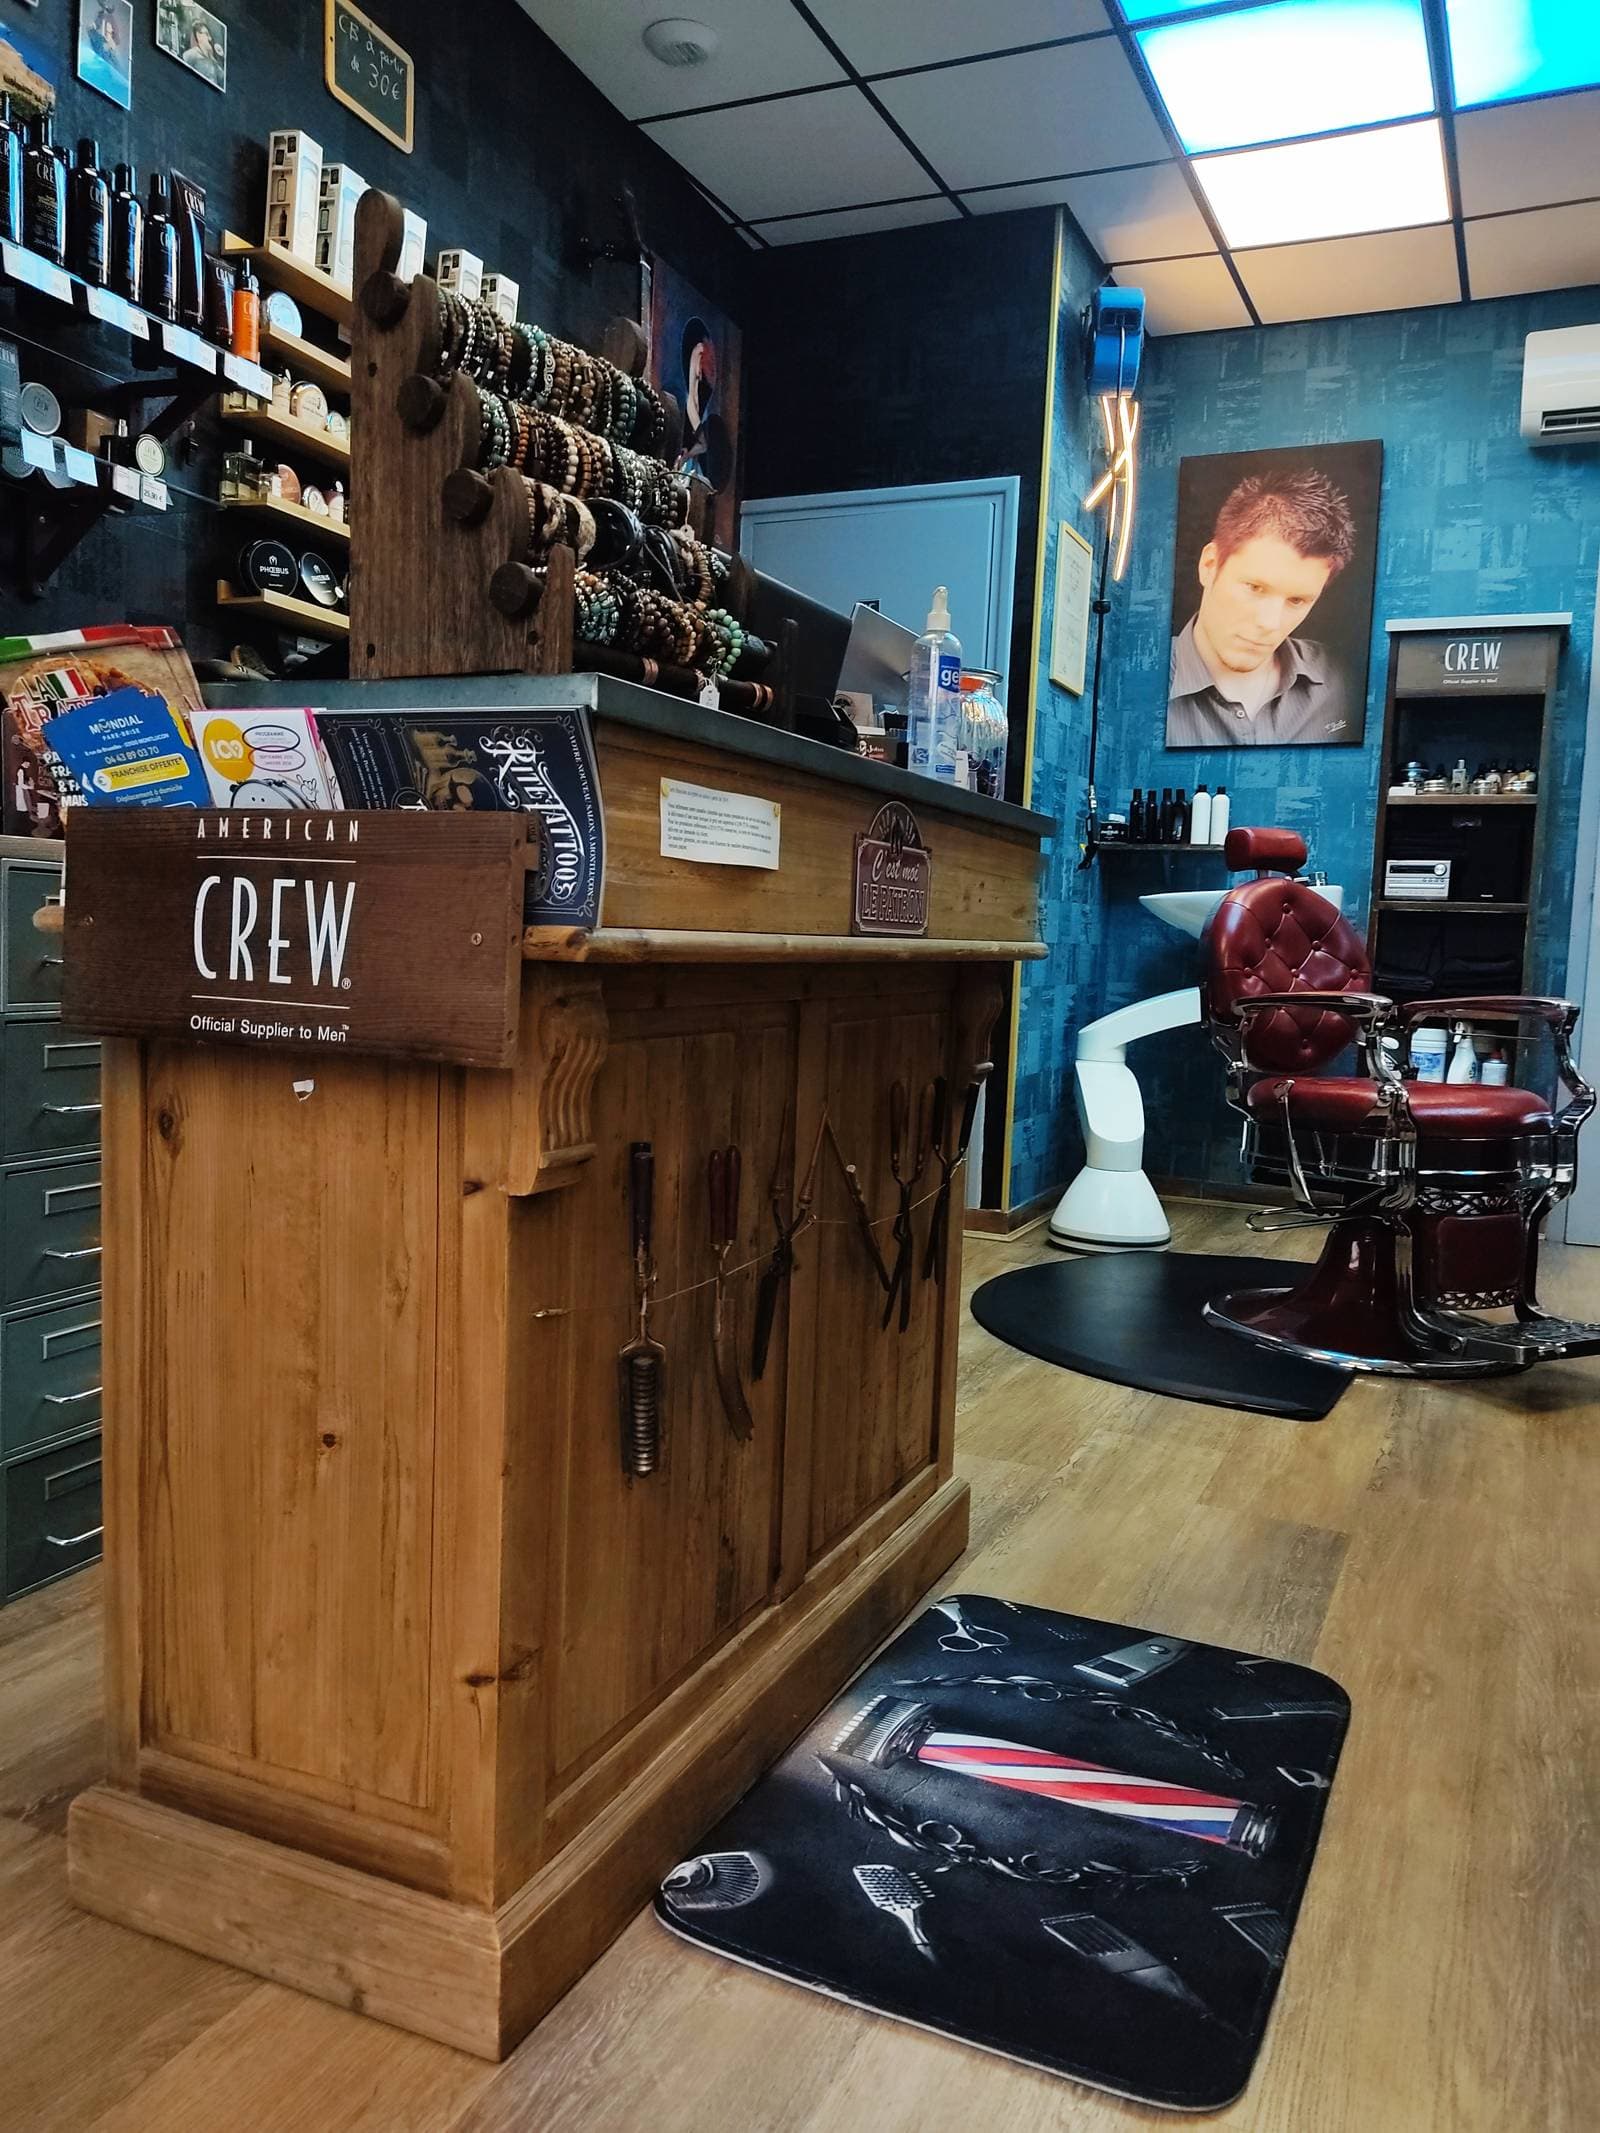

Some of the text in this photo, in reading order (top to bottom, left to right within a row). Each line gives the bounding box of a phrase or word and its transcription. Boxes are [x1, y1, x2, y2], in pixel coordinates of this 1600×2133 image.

[338, 14, 359, 41] CB
[350, 55, 360, 73] de
[42, 752, 62, 765] PA
[110, 763, 150, 780] FRANCHISE
[57, 780, 68, 793] &
[197, 816, 360, 842] AMERICAN
[862, 882, 925, 924] LE PATRON
[190, 1014, 236, 1033] Official
[240, 1018, 295, 1039] Supplier
[299, 1024, 313, 1040] to
